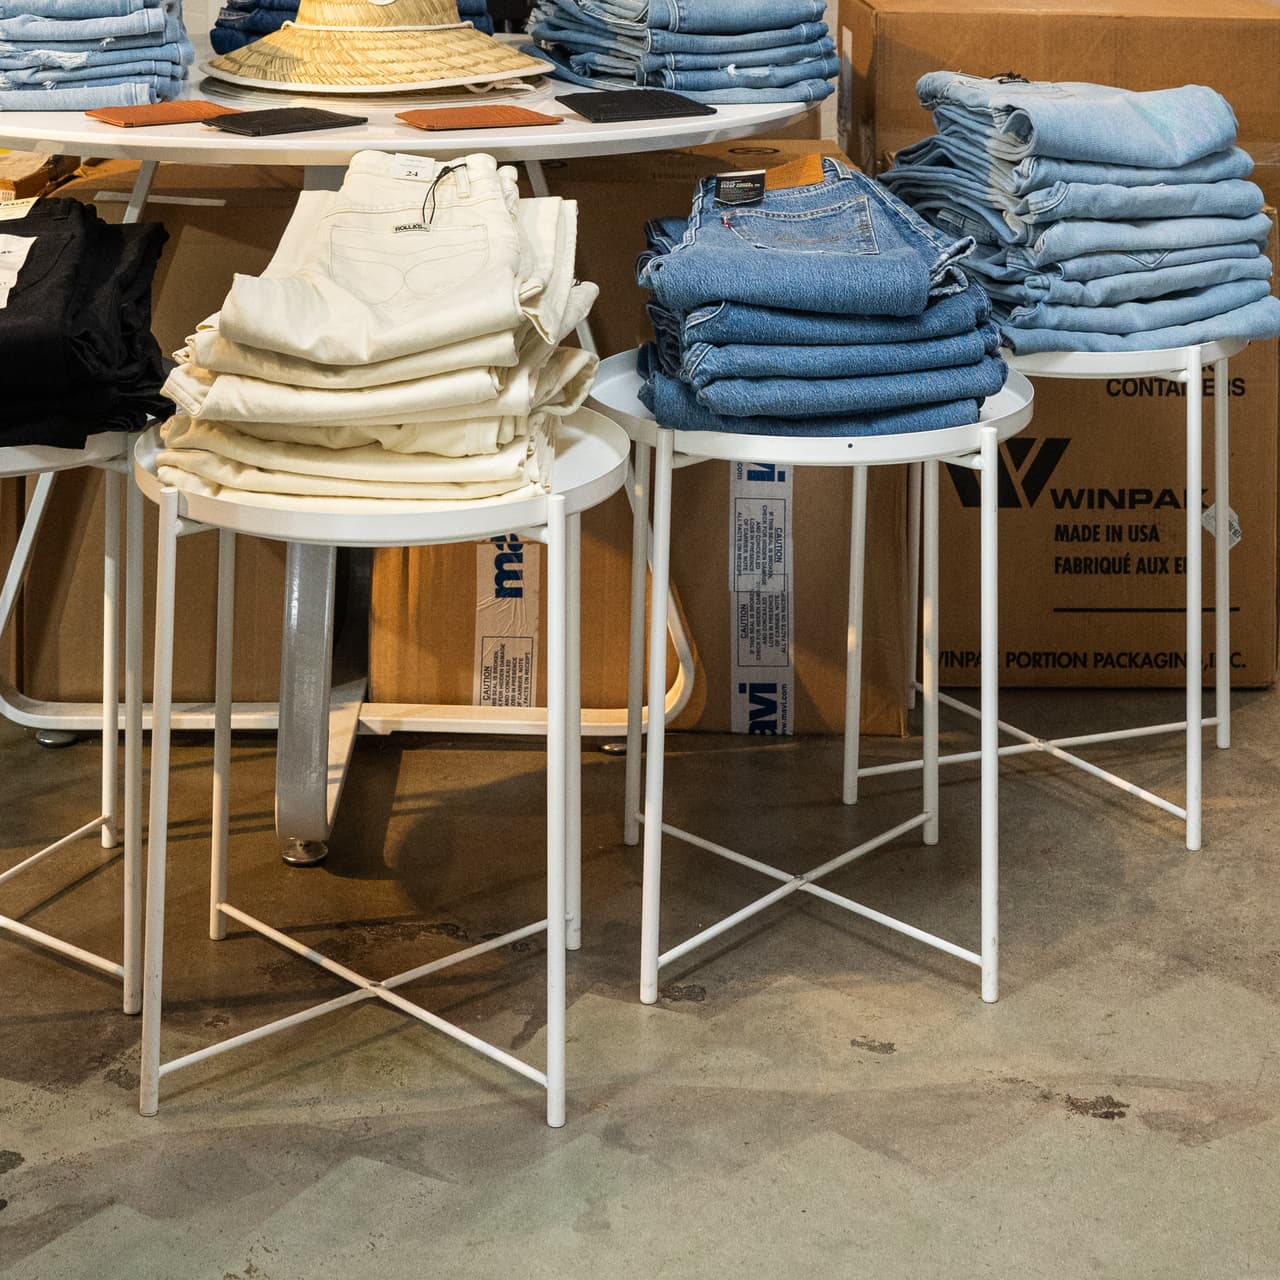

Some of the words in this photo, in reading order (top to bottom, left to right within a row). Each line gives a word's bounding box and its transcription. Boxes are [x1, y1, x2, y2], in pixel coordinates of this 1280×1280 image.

[1054, 524, 1100, 542] MADE
[1106, 524, 1123, 542] IN
[1128, 524, 1160, 542] USA
[1054, 552, 1131, 575] FABRIQUÉ
[1135, 556, 1170, 574] AUX
[1006, 651, 1087, 668] PORTION
